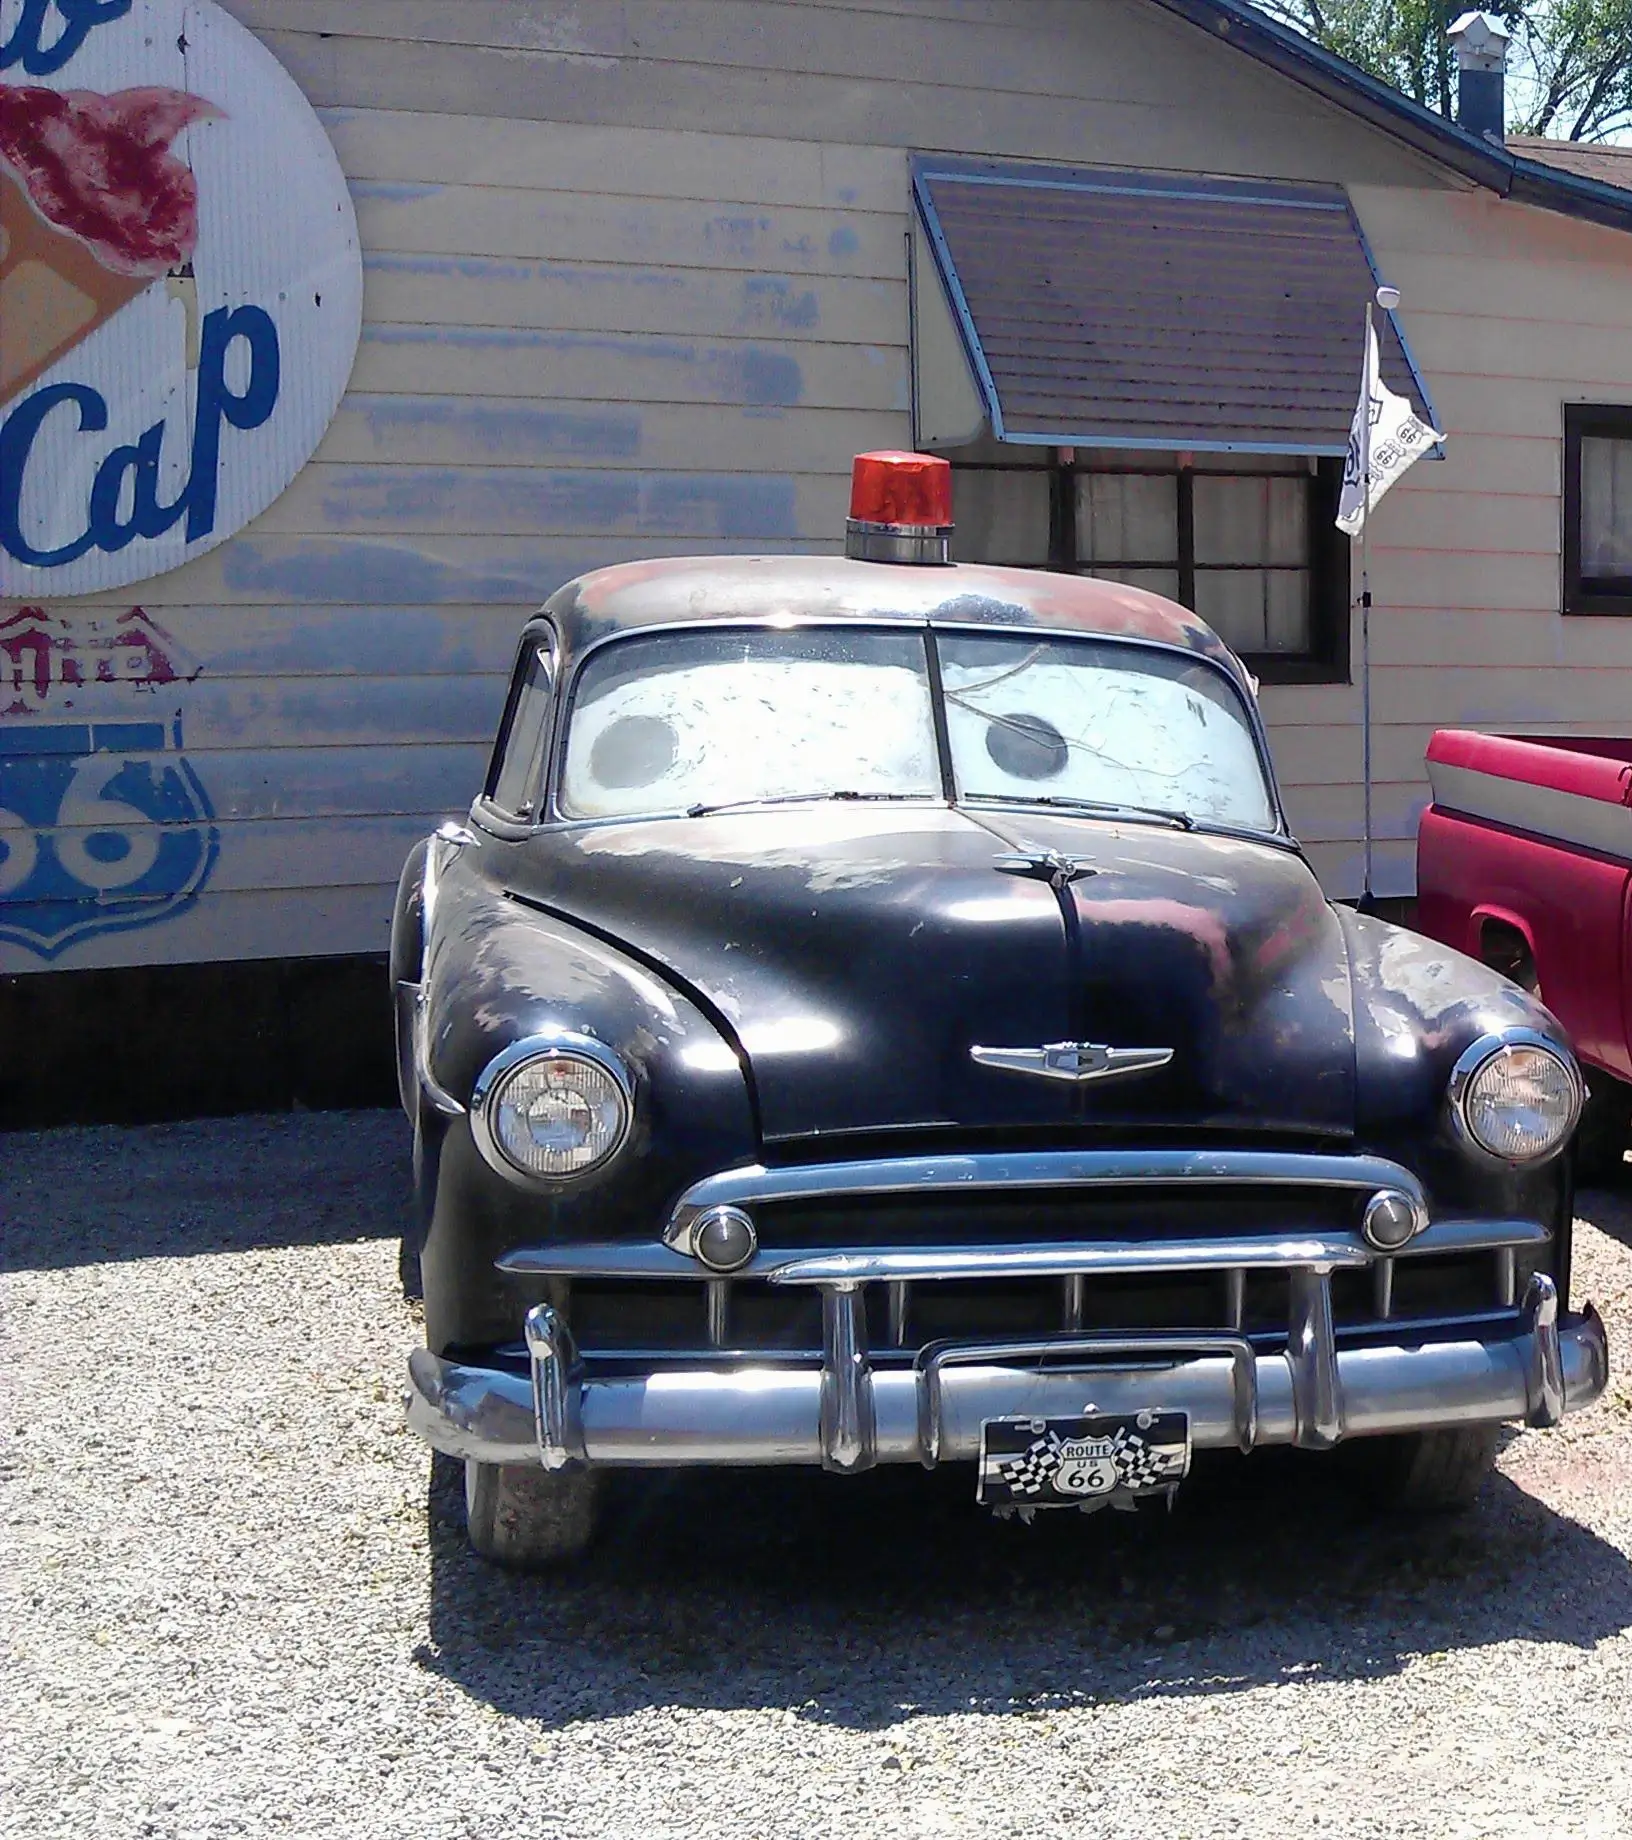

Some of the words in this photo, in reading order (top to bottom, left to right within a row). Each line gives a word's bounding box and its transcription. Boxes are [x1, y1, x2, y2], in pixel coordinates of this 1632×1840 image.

[0, 303, 279, 568] Cap
[1066, 1444, 1110, 1457] ROUTE
[1076, 1460, 1099, 1468] US
[1068, 1469, 1105, 1488] 66
